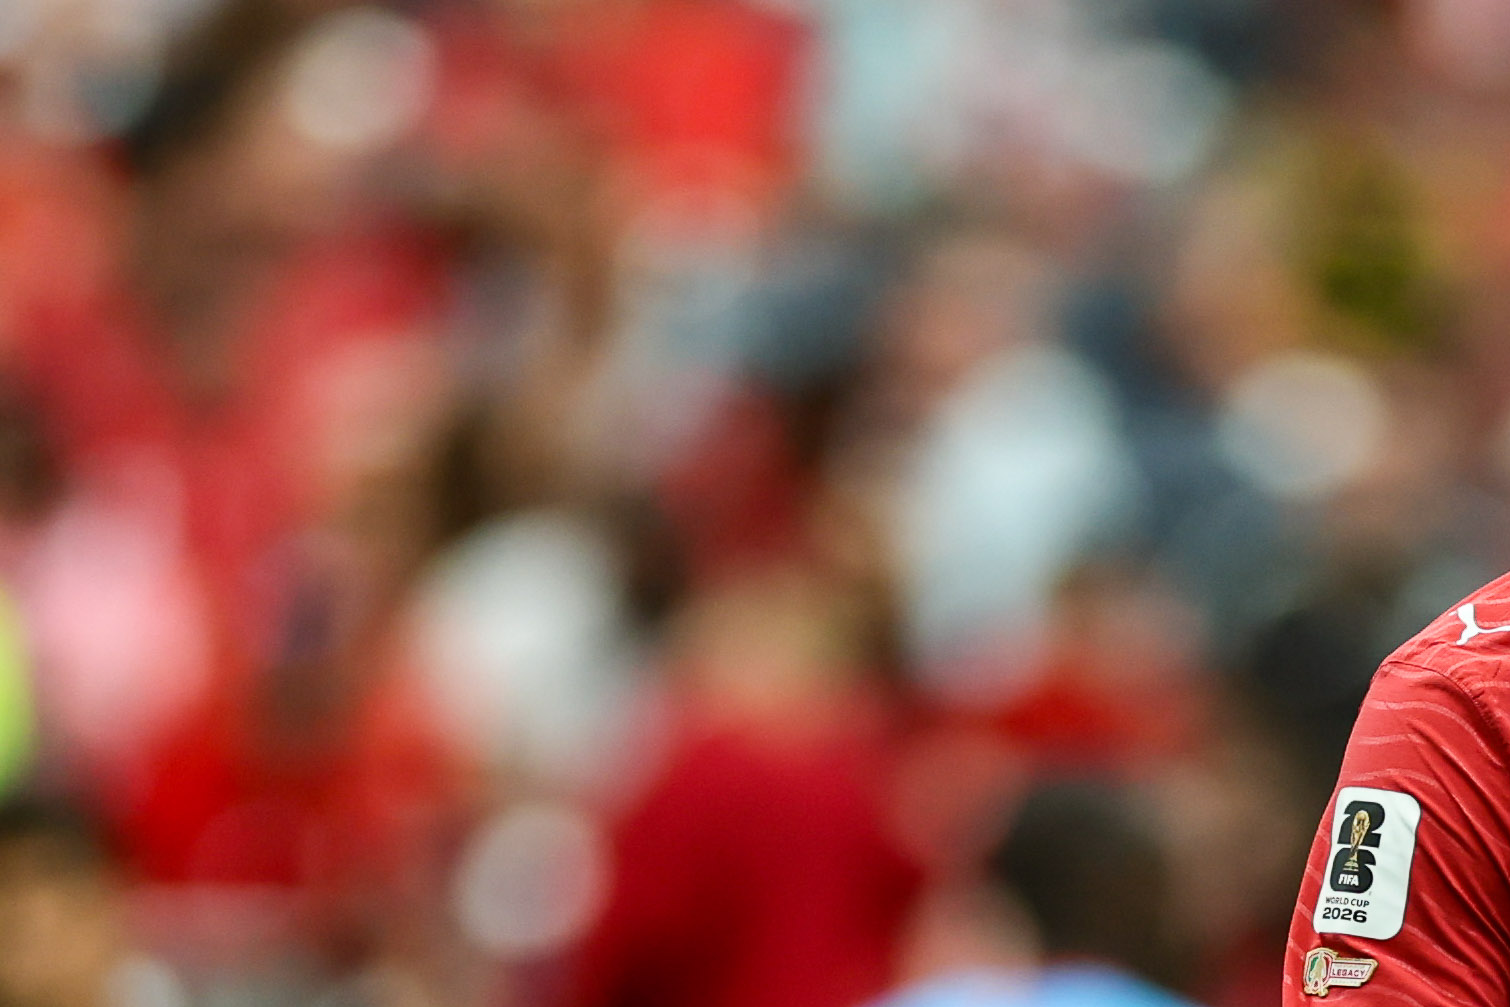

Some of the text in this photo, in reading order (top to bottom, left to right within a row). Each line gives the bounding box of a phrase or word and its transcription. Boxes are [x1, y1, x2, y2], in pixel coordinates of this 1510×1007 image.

[1338, 873, 1360, 887] FIFA
[1325, 896, 1371, 908] WORLD CUP
[1322, 907, 1368, 924] 2026
[1332, 968, 1366, 977] LEGACY
